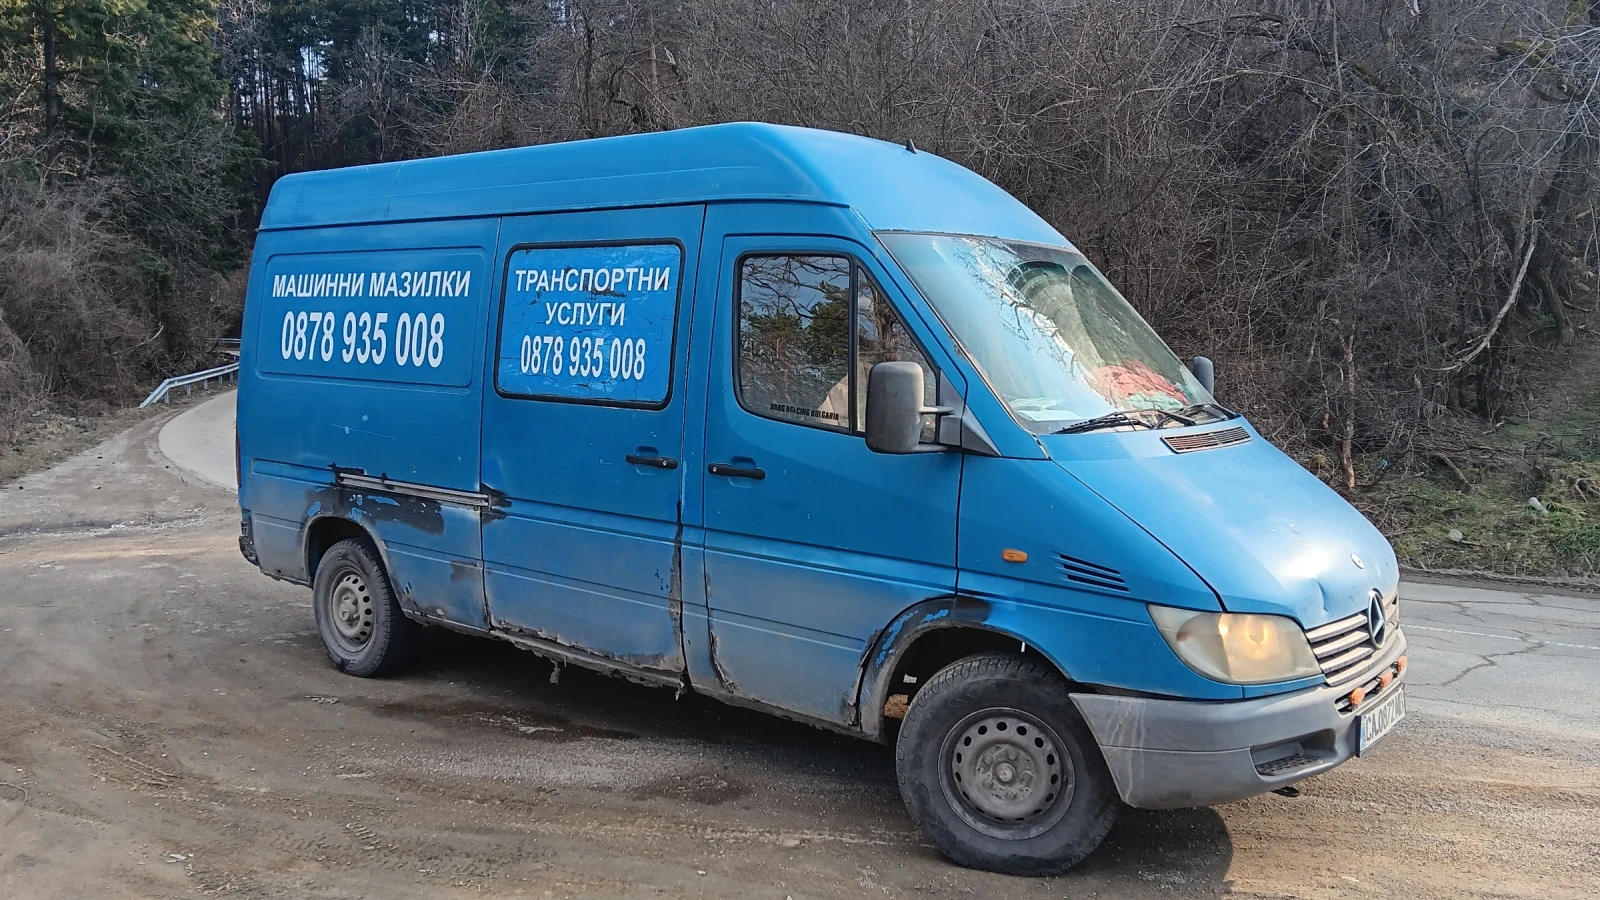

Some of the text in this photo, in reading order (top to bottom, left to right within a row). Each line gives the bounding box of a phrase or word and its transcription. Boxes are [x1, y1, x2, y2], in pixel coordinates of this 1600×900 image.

[272, 270, 471, 298] МАШИННИ МАЗИЛКИ
[515, 267, 671, 292] ТРАНСПОРТНИ
[545, 302, 626, 326] УСЛУГИ
[281, 310, 445, 368] 0878 935 008
[520, 334, 646, 380] 0878 935 008
